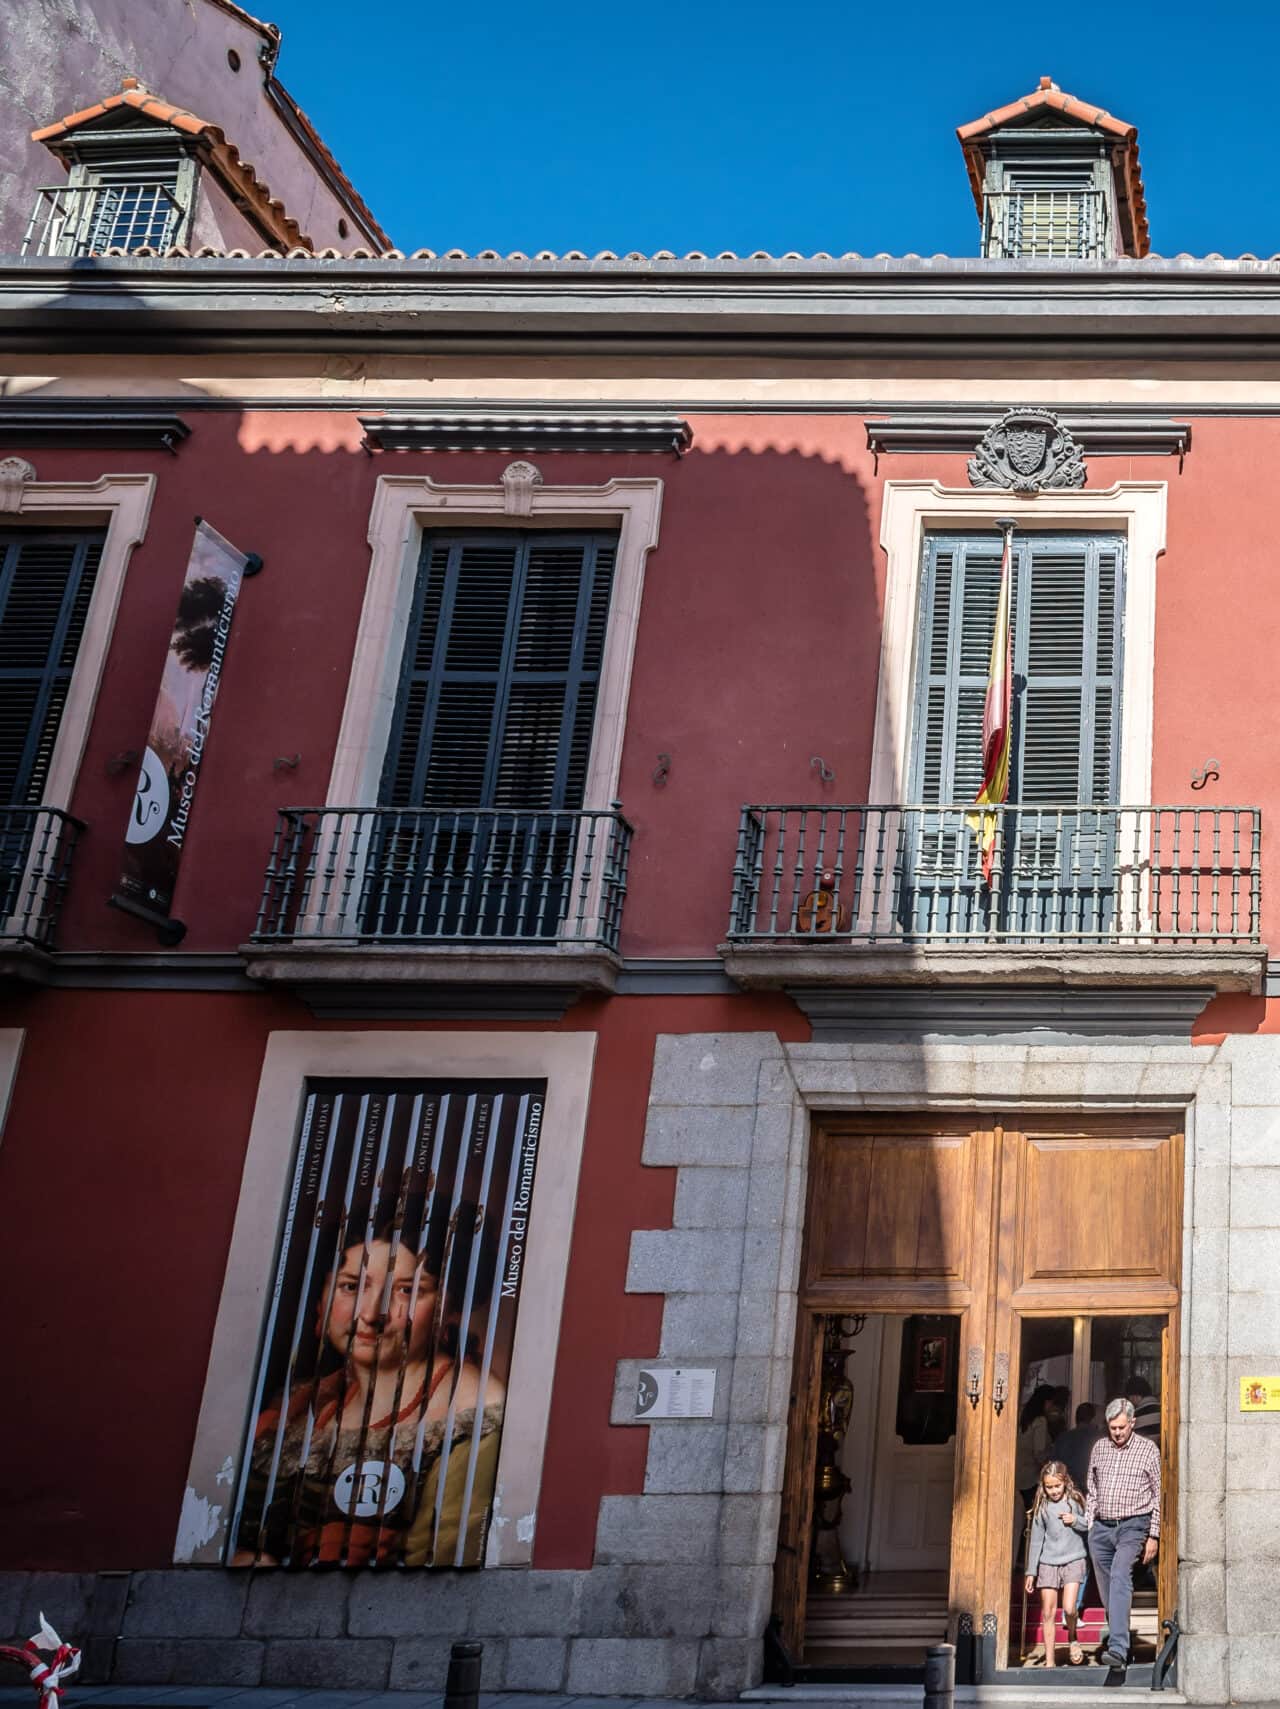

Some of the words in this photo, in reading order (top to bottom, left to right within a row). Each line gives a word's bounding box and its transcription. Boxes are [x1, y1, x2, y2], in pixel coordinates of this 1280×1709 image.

[194, 570, 240, 727] Romanticismo
[186, 727, 206, 766] del
[167, 771, 197, 849] Museo
[306, 1153, 320, 1195] VISITAS
[314, 1103, 329, 1151] GUIADAS
[360, 1103, 381, 1186] CONFERENCIAS
[417, 1102, 435, 1172] CONCIERTOS
[474, 1103, 488, 1154] TALLERES
[513, 1102, 542, 1213] Romanticismo
[509, 1216, 527, 1240] del
[502, 1245, 522, 1299] Museo
